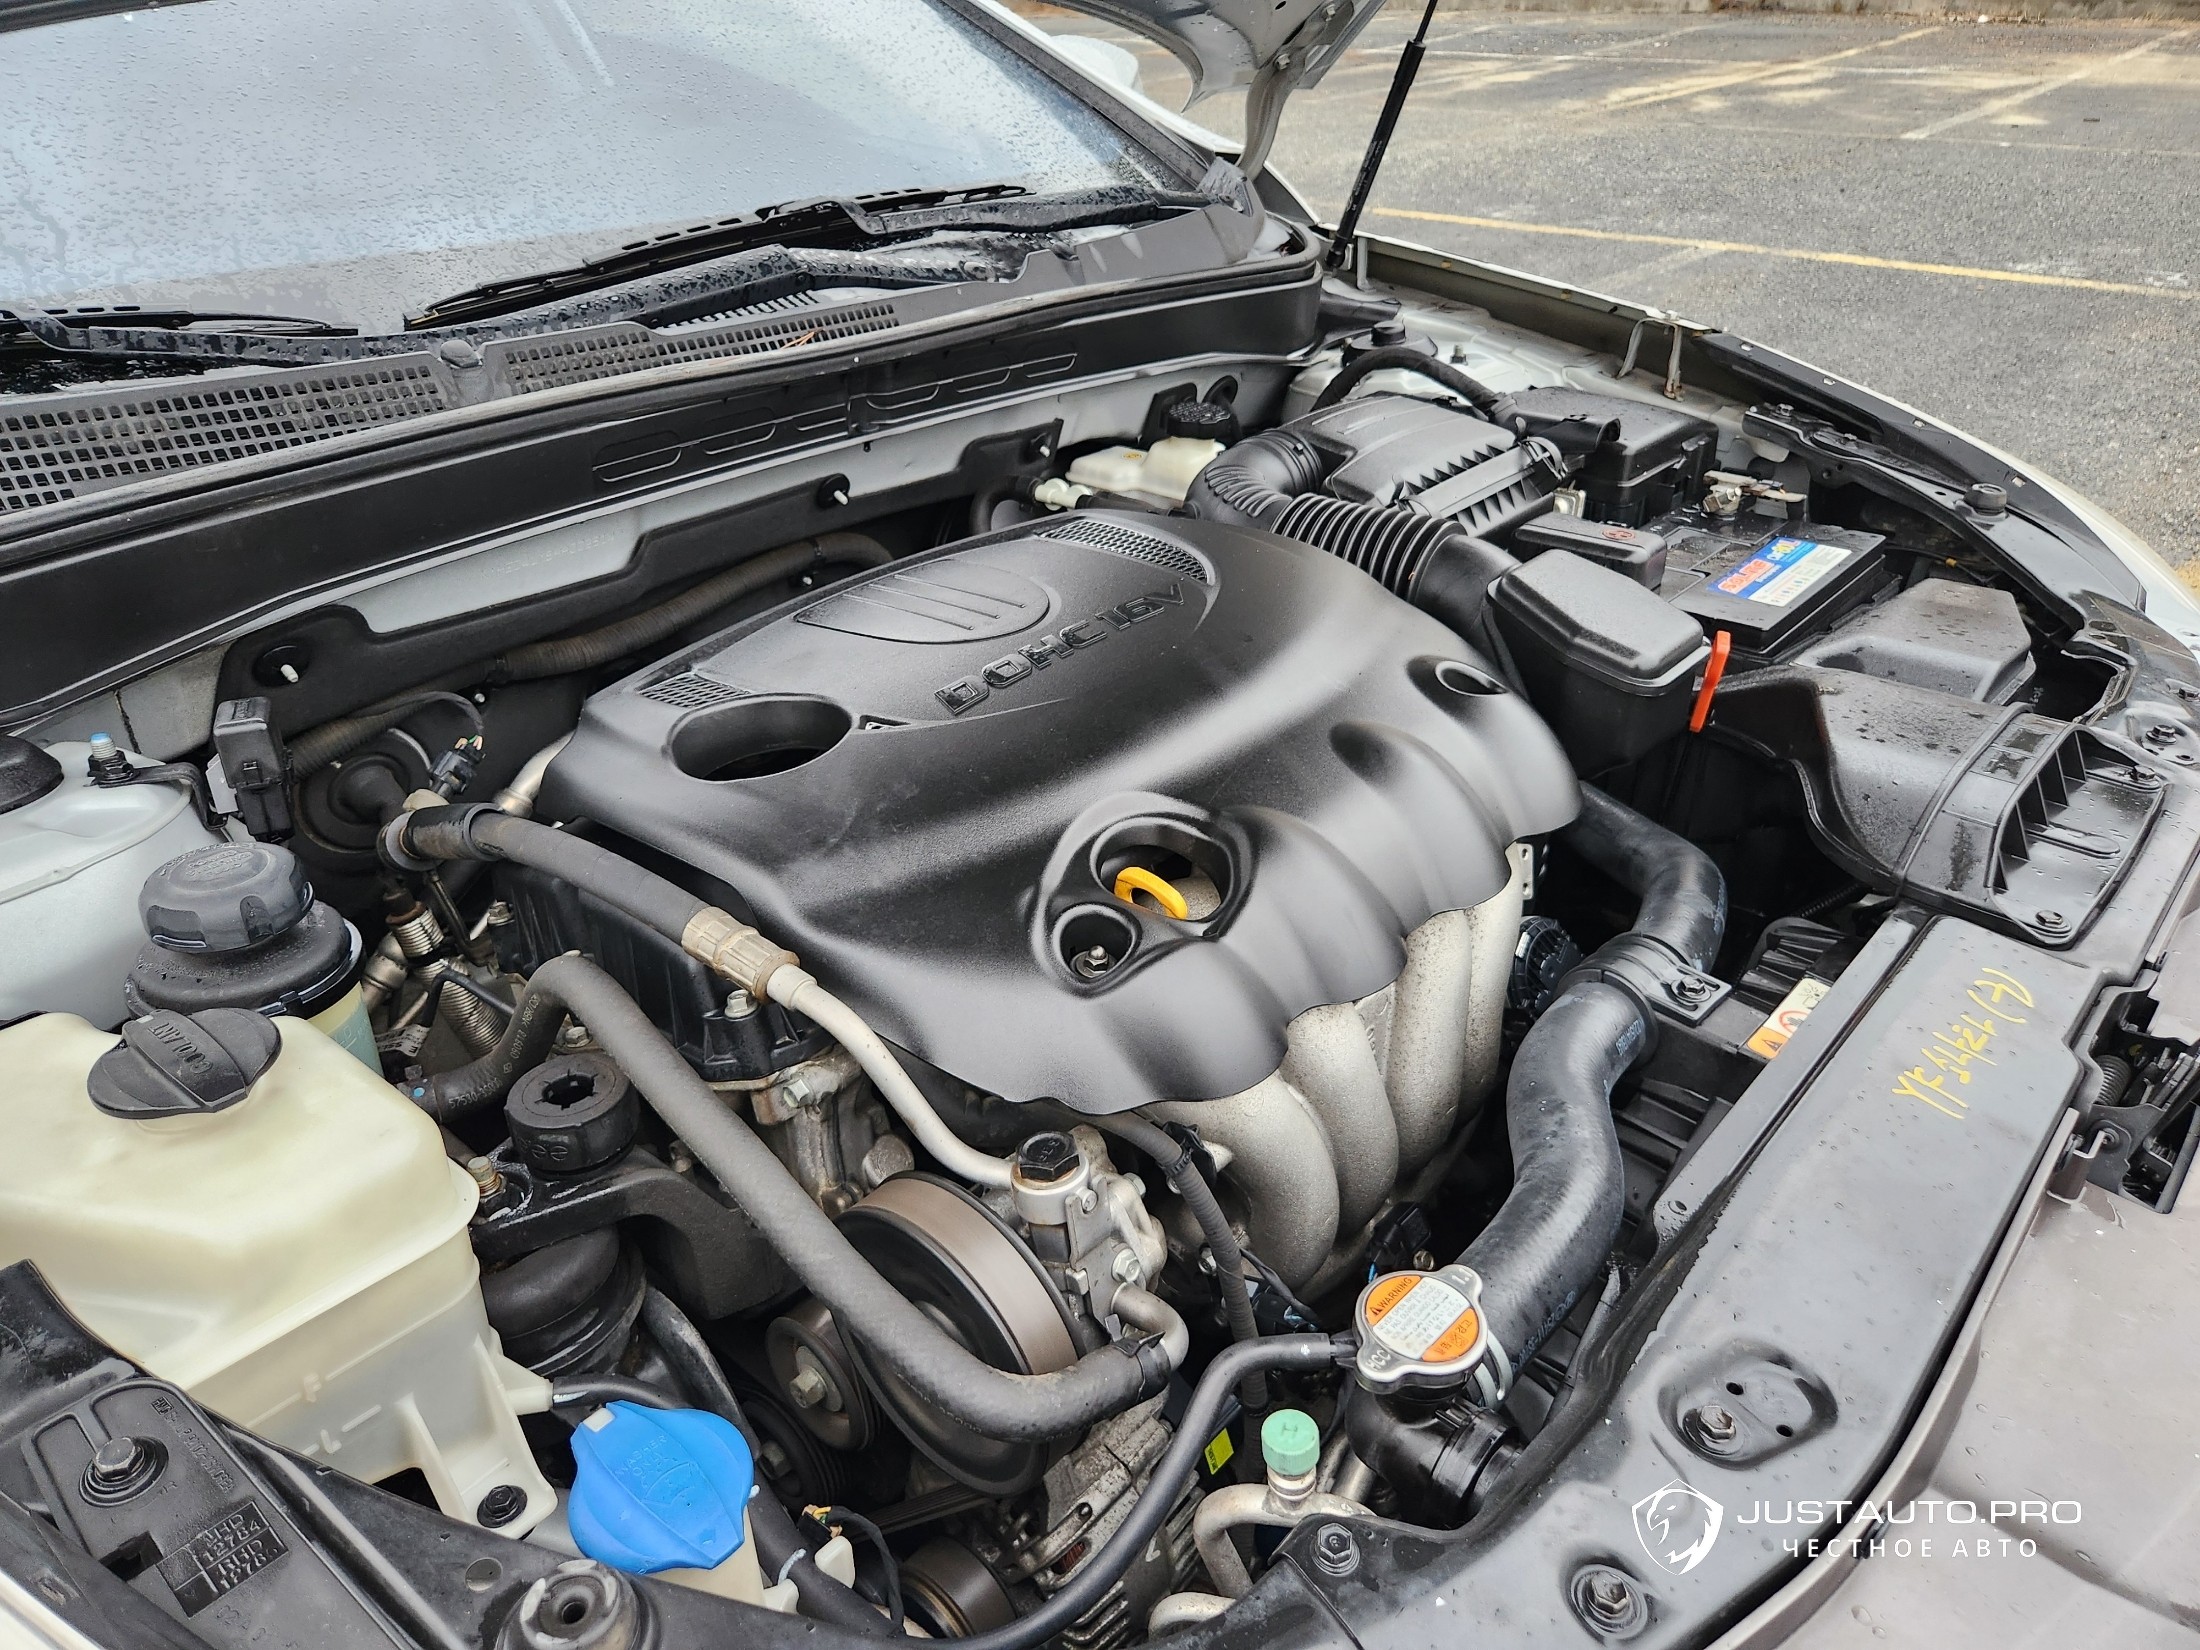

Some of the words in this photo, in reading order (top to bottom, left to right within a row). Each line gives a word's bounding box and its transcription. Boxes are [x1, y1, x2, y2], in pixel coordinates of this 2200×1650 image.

[934, 619, 1108, 715] DOHC
[1094, 583, 1184, 631] 16V
[147, 1022, 214, 1075] COOLANT
[1378, 1277, 1413, 1310] WARNING
[1365, 1349, 1392, 1372] HCC
